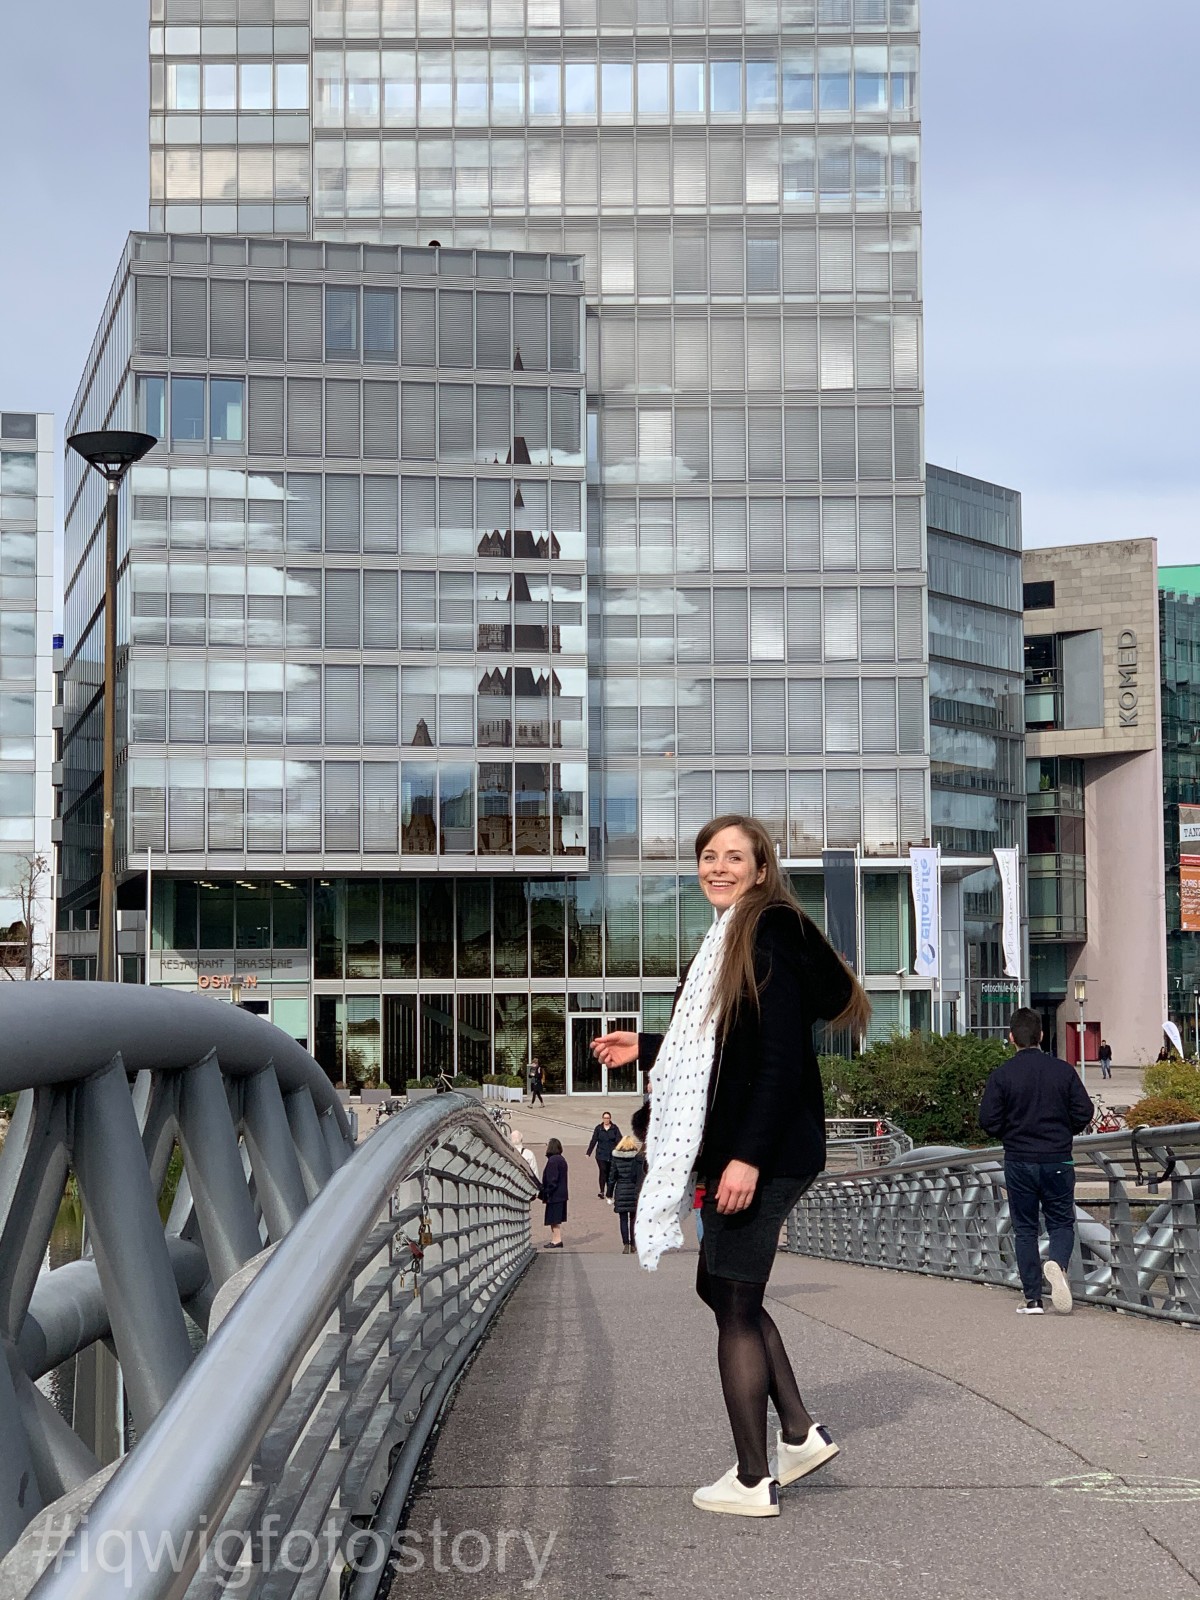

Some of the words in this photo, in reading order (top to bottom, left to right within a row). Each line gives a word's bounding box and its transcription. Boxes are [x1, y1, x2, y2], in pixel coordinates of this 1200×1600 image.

[1118, 629, 1138, 727] KOMED
[160, 959, 224, 970] RESTAURANT
[237, 959, 293, 969] BRASSERIE
[198, 975, 257, 989] OSMN
